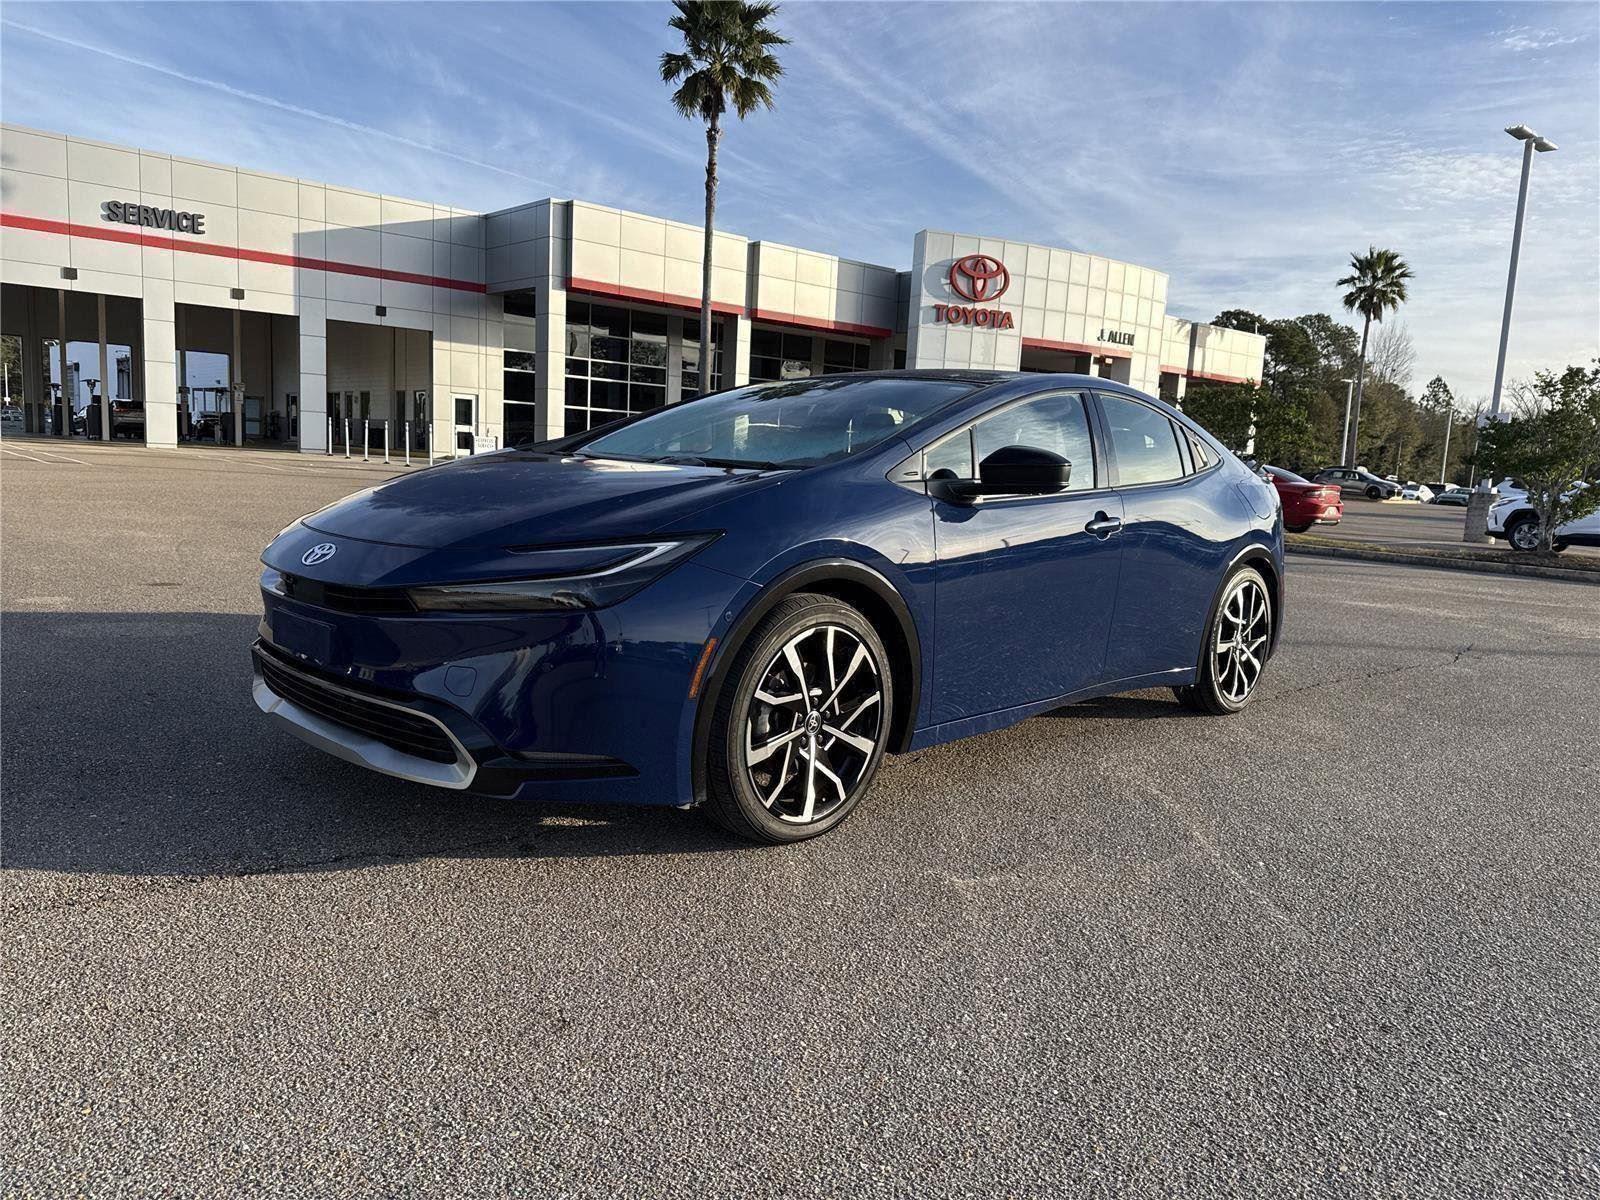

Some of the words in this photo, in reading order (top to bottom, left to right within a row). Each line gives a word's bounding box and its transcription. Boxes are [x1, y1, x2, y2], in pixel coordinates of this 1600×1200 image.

[107, 200, 205, 234] SERVICE
[933, 303, 1015, 329] TOYOTA
[1097, 328, 1106, 342] J.
[1107, 330, 1135, 346] ALLEN
